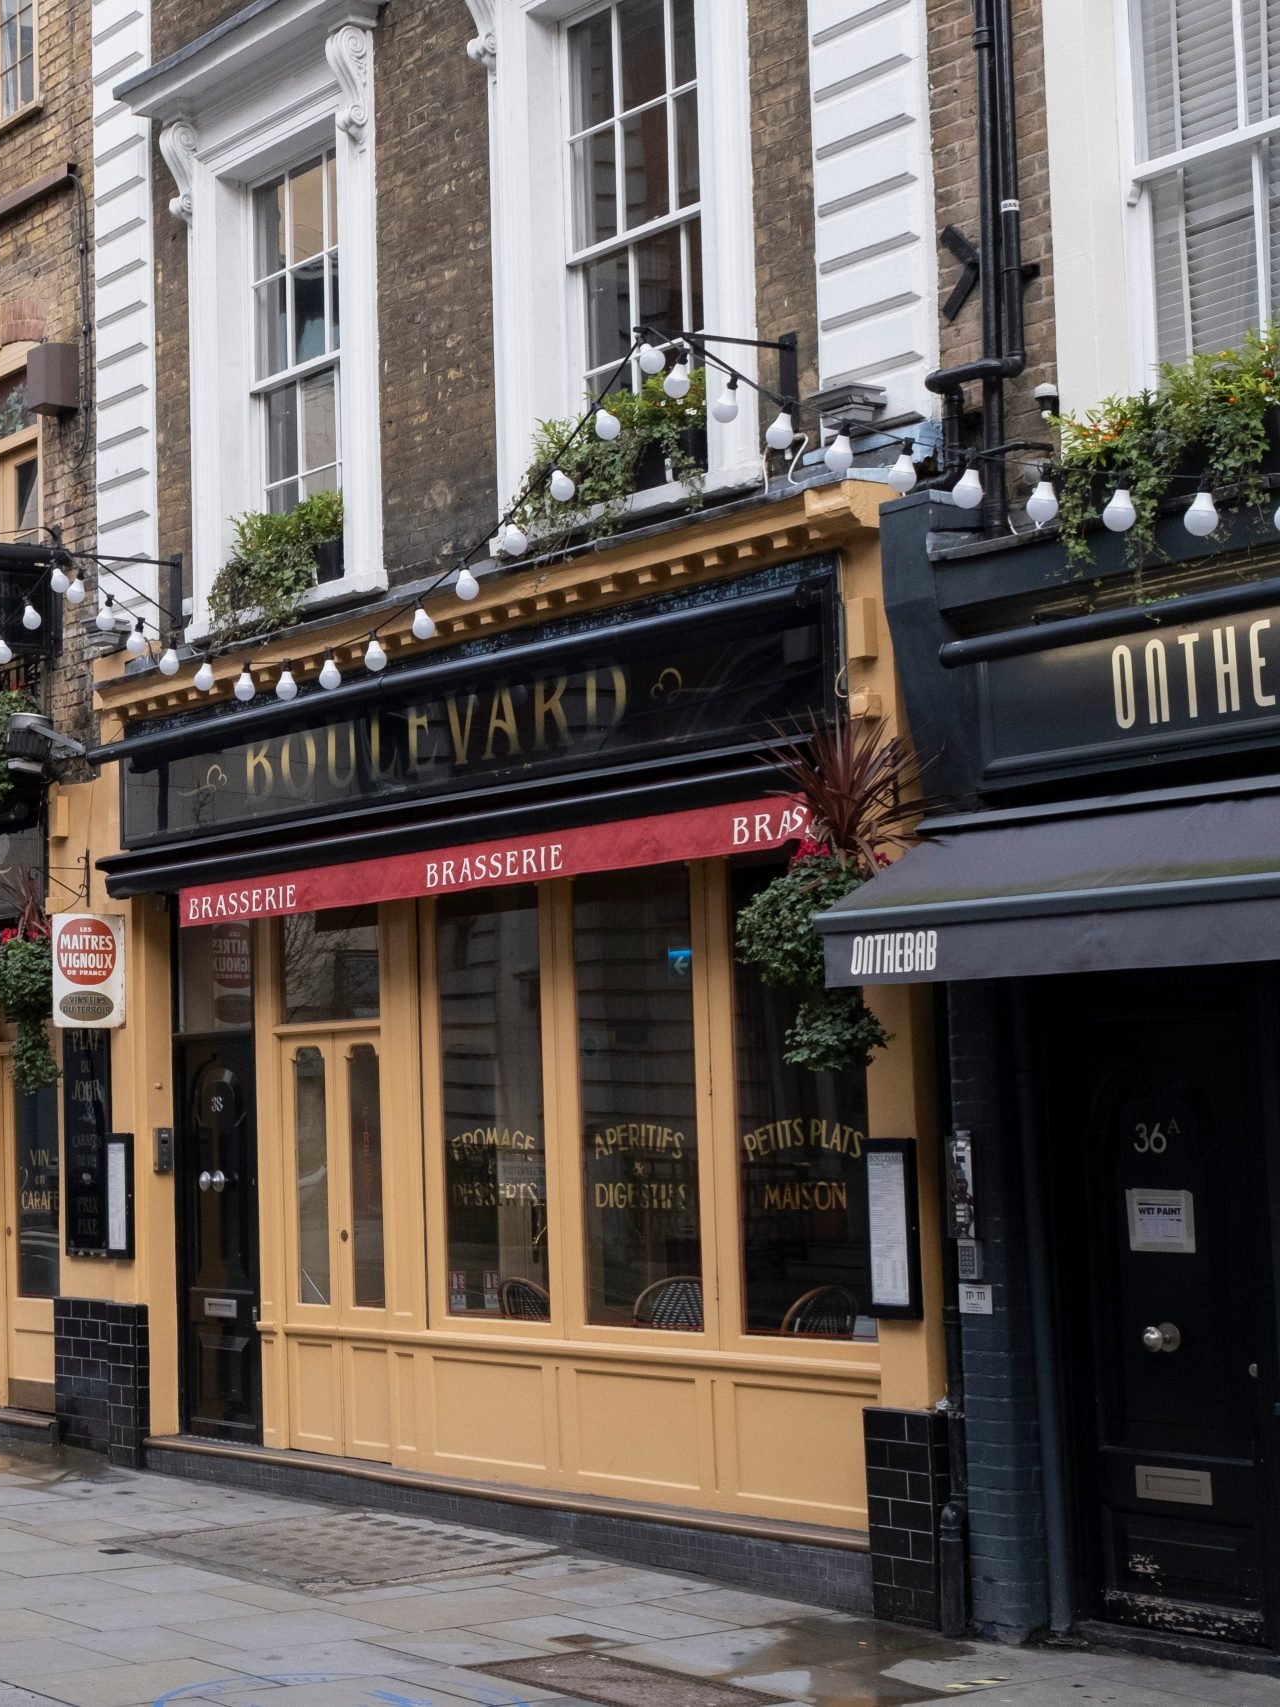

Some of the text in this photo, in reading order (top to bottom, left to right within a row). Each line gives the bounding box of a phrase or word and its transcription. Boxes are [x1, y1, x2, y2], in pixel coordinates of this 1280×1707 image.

[1112, 619, 1276, 729] ONTHE
[244, 657, 629, 803] BOULEVARD
[733, 806, 816, 845] BRAS
[426, 844, 563, 888] BRASSERIE
[189, 885, 297, 920] BRASSERIE
[60, 935, 113, 950] MAITRES
[851, 931, 937, 975] ONTHEBAB
[60, 952, 113, 969] VIGNOUX
[69, 995, 106, 1004] VINS FINS
[77, 1006, 111, 1014] TERROIR
[72, 1029, 100, 1052] PLAT
[80, 1060, 91, 1073] DU
[72, 1079, 101, 1101] JOUR
[211, 1096, 223, 1111] 38
[451, 1127, 535, 1161] FROMAGE
[595, 1123, 685, 1160] APERITIFS
[743, 1118, 864, 1162] PETITS PLATS
[30, 1149, 49, 1167] VIN
[764, 1181, 847, 1211] MAISON
